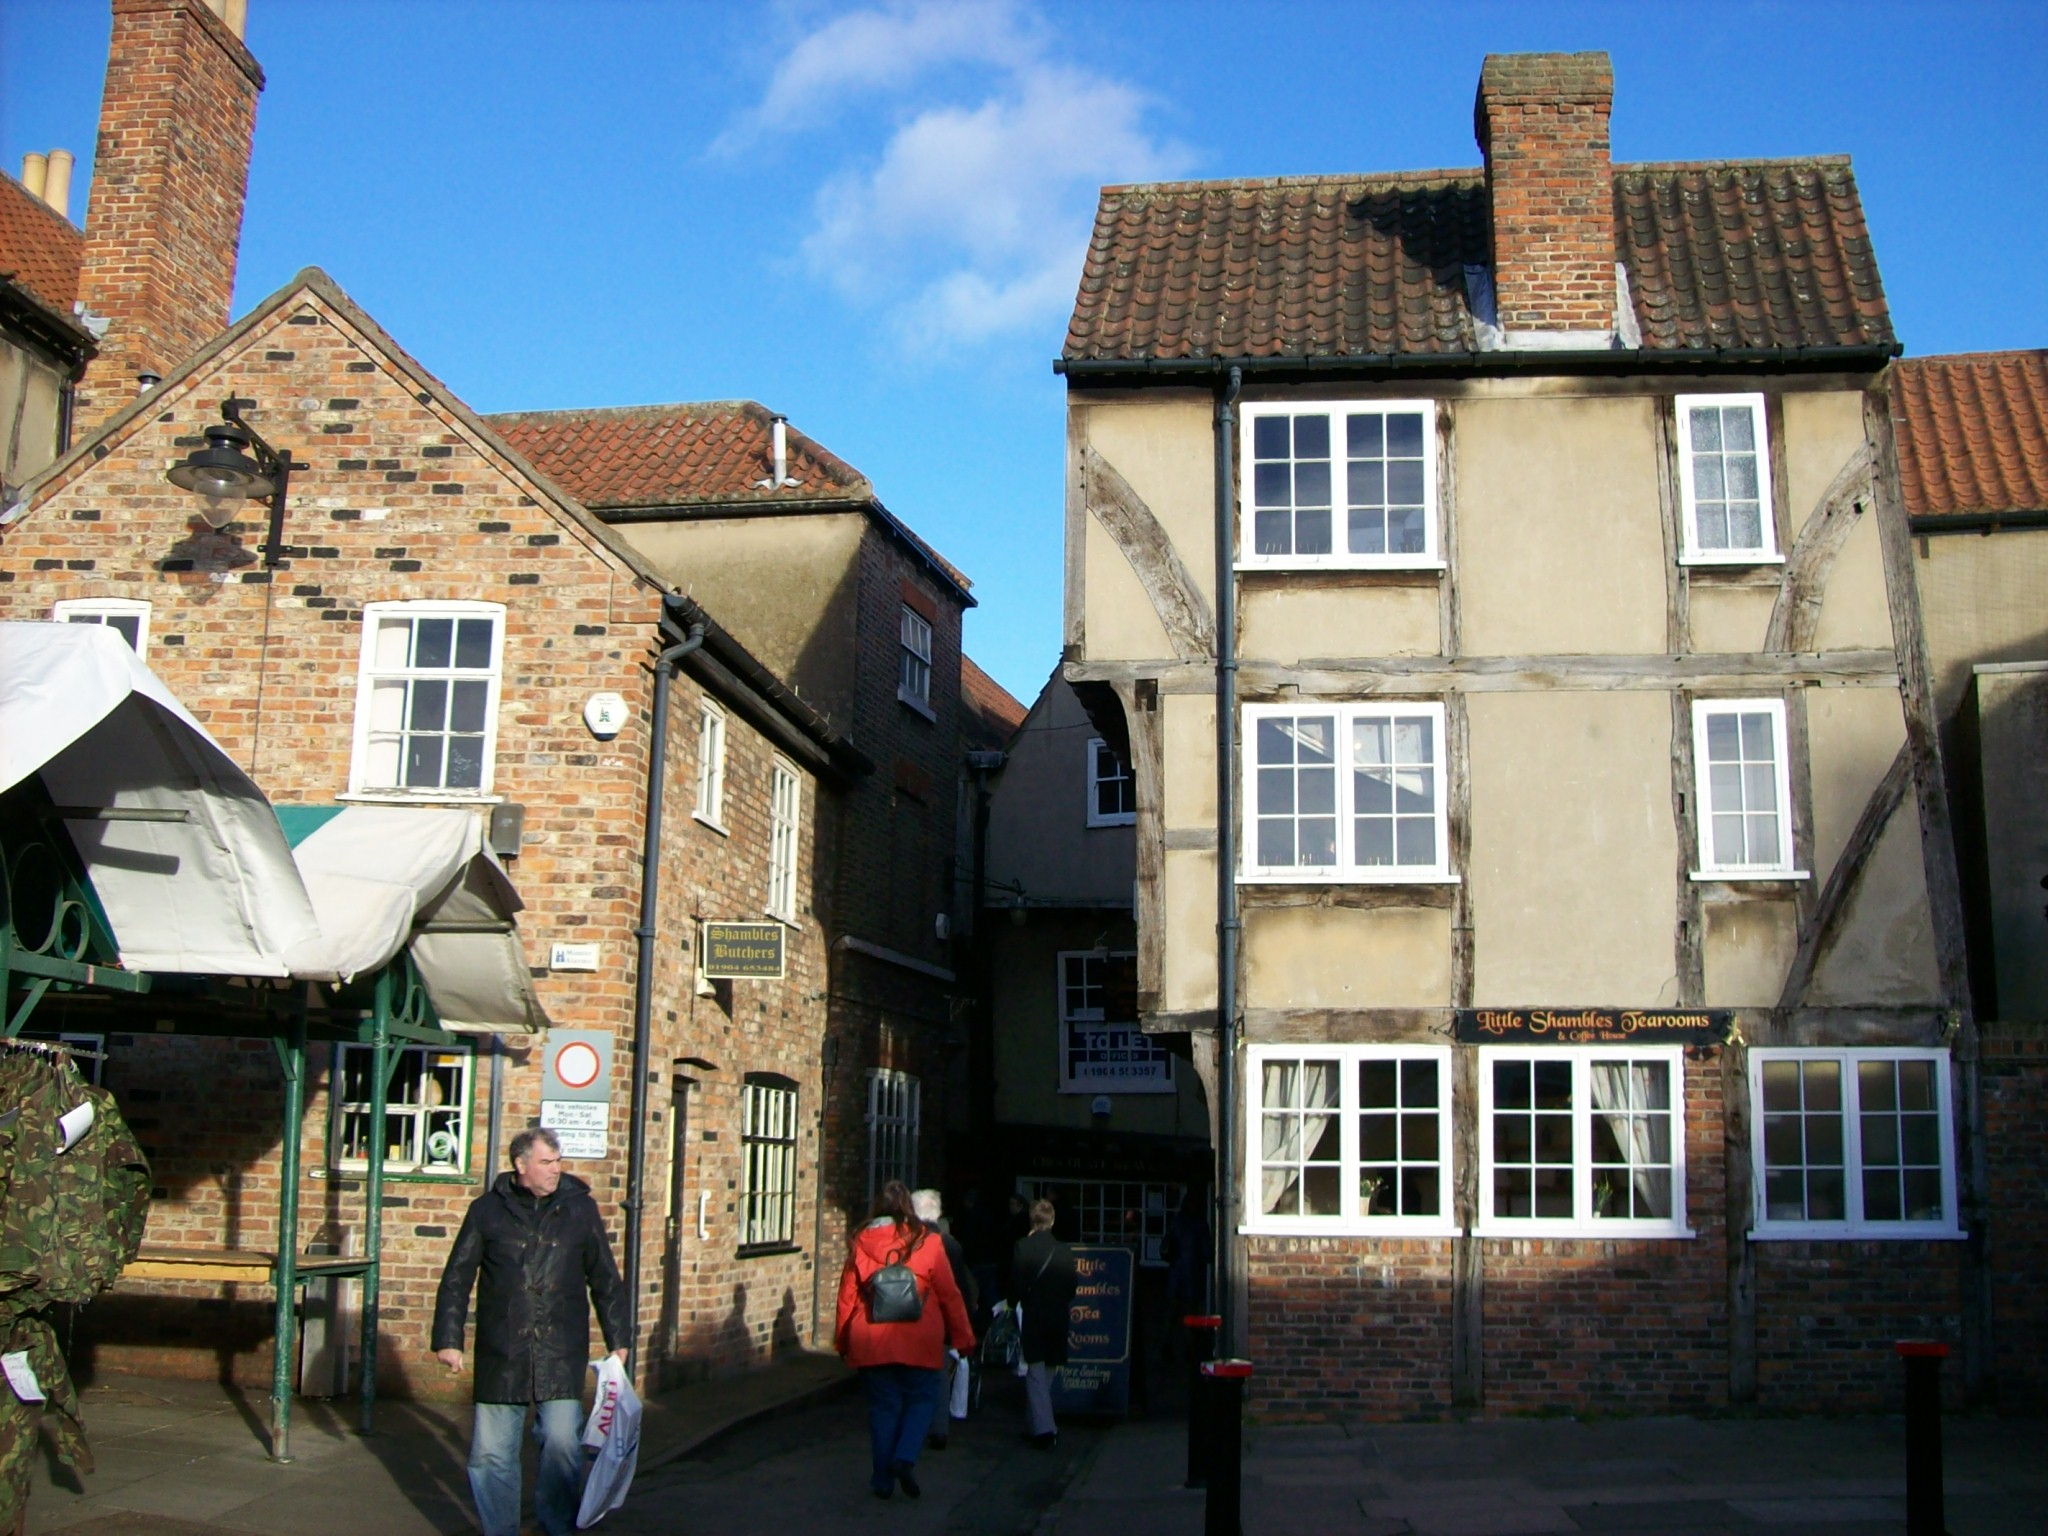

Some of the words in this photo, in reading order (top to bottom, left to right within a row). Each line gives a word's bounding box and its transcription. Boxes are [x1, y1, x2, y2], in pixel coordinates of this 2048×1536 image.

[710, 926, 779, 942] Shambles
[714, 944, 776, 960] Butchers
[1476, 1011, 1524, 1035] Little
[1529, 1011, 1614, 1033] Shambles
[1621, 1011, 1710, 1033] Tearooms
[1557, 1031, 1566, 1041] &
[1569, 1030, 1597, 1042] Coffee
[1600, 1031, 1628, 1040] House
[558, 1110, 574, 1118] Mon
[579, 1111, 593, 1119] Sat
[567, 1103, 597, 1111] vehicles
[1073, 1257, 1107, 1278] Little
[1074, 1280, 1121, 1297] ambles
[1069, 1304, 1102, 1324] Tea
